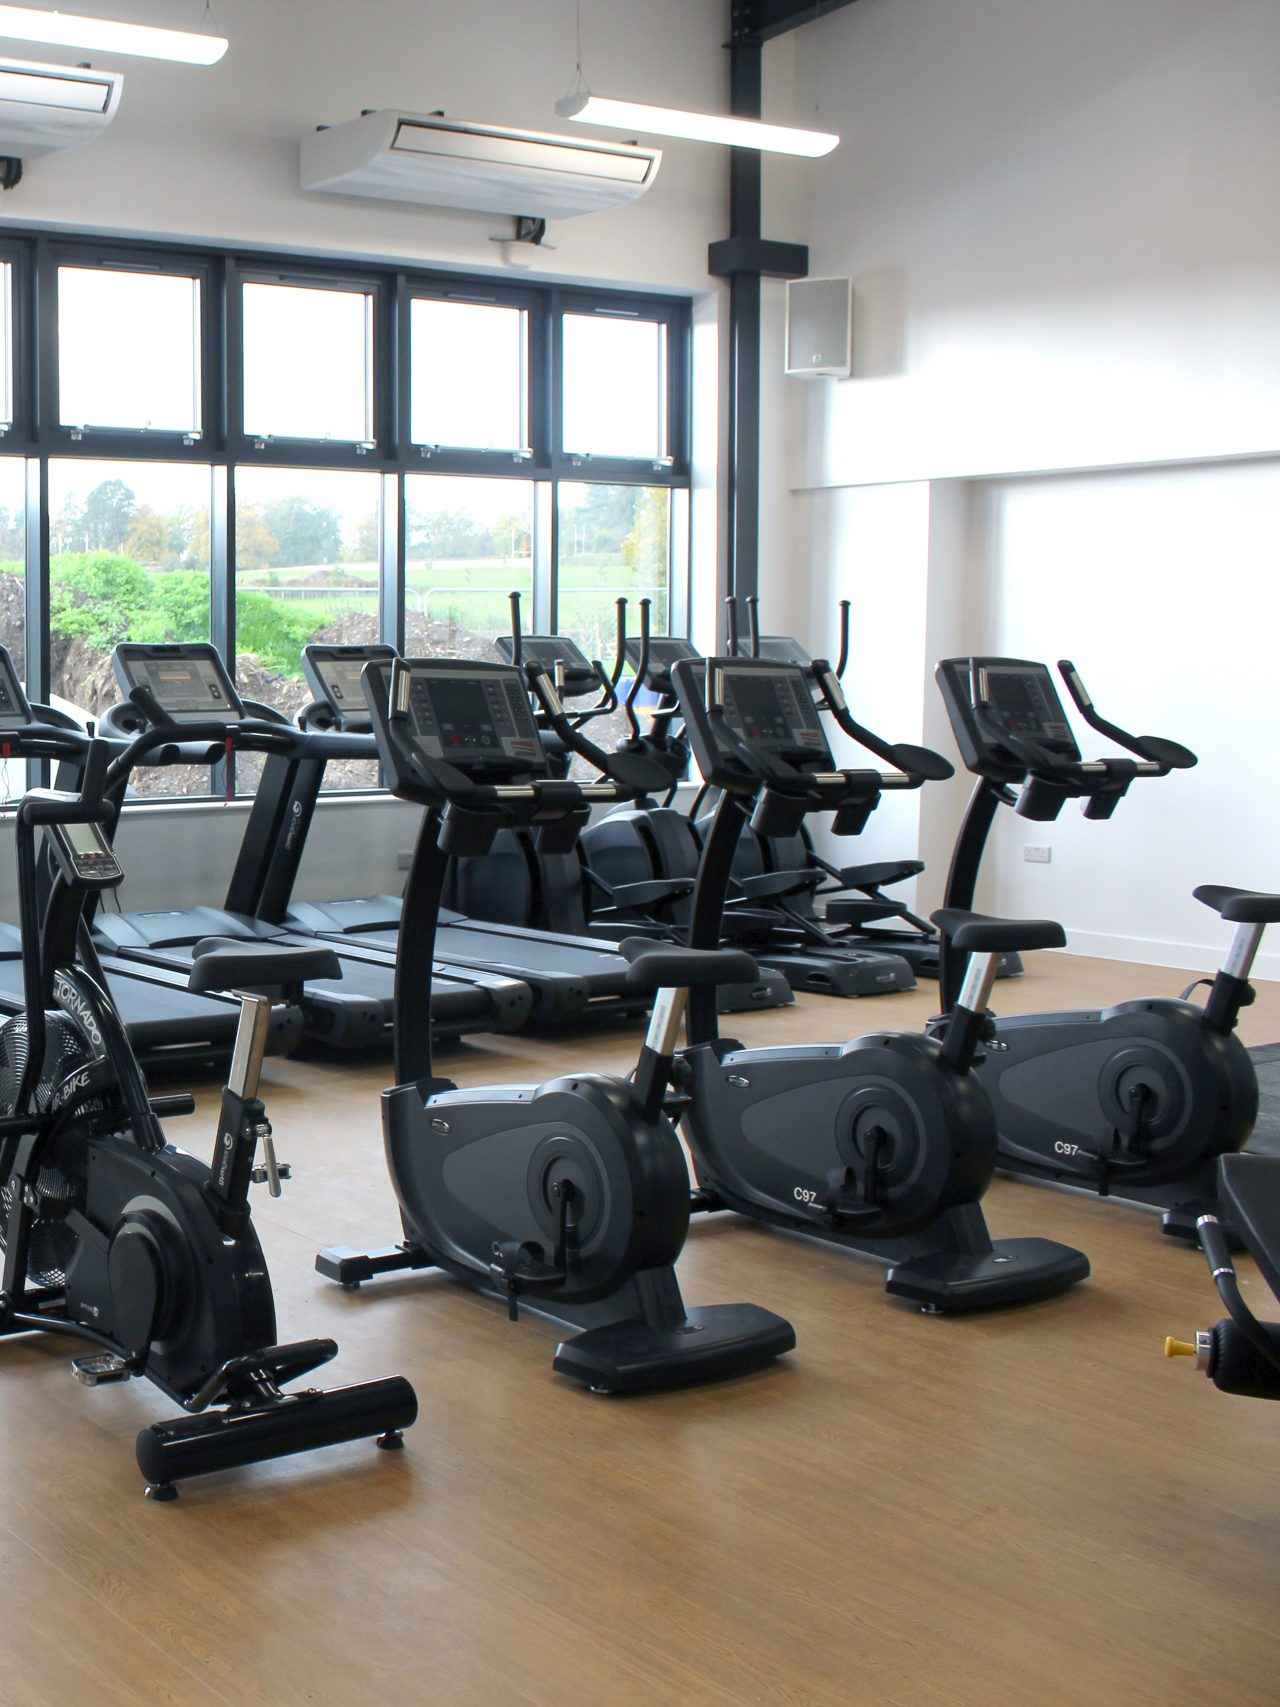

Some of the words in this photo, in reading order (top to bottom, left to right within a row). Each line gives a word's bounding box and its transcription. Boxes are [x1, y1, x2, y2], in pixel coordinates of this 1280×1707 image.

[55, 979, 102, 1045] TORNADO
[1055, 1141, 1079, 1156] C97
[793, 1187, 817, 1202] C97
